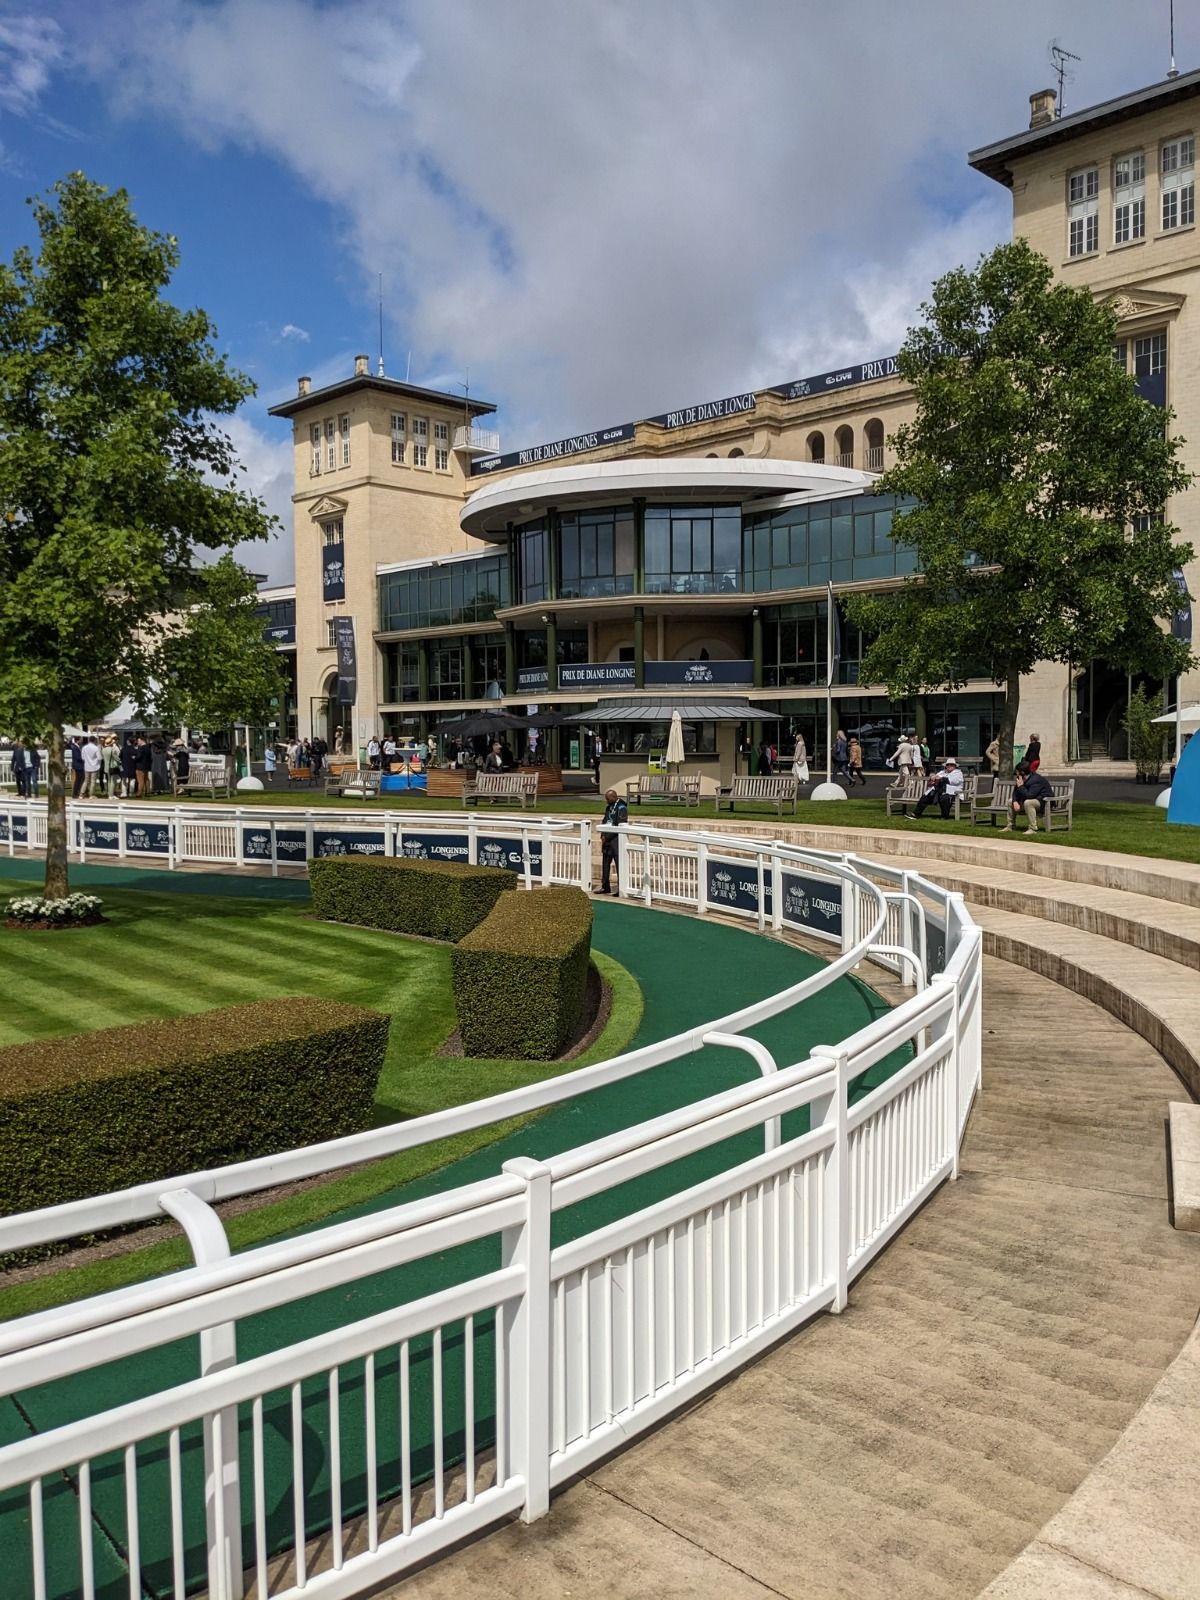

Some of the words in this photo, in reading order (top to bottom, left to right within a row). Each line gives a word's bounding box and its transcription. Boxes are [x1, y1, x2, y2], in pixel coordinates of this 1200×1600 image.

[861, 360, 883, 380] PRIX
[667, 410, 684, 428] PRIX
[686, 408, 697, 424] DE
[698, 401, 724, 421] DIANE
[725, 394, 757, 414] LONGIN
[519, 450, 533, 465] PRIX
[533, 447, 543, 461] DE
[543, 442, 564, 460] DIANE
[564, 432, 598, 453] LONGINES
[562, 670, 576, 680] PRIX
[576, 670, 585, 680] DE
[586, 669, 605, 680] DIANE
[349, 843, 386, 851] LONGINES
[430, 846, 469, 855] LONGINES
[812, 897, 842, 914] LONGINE
